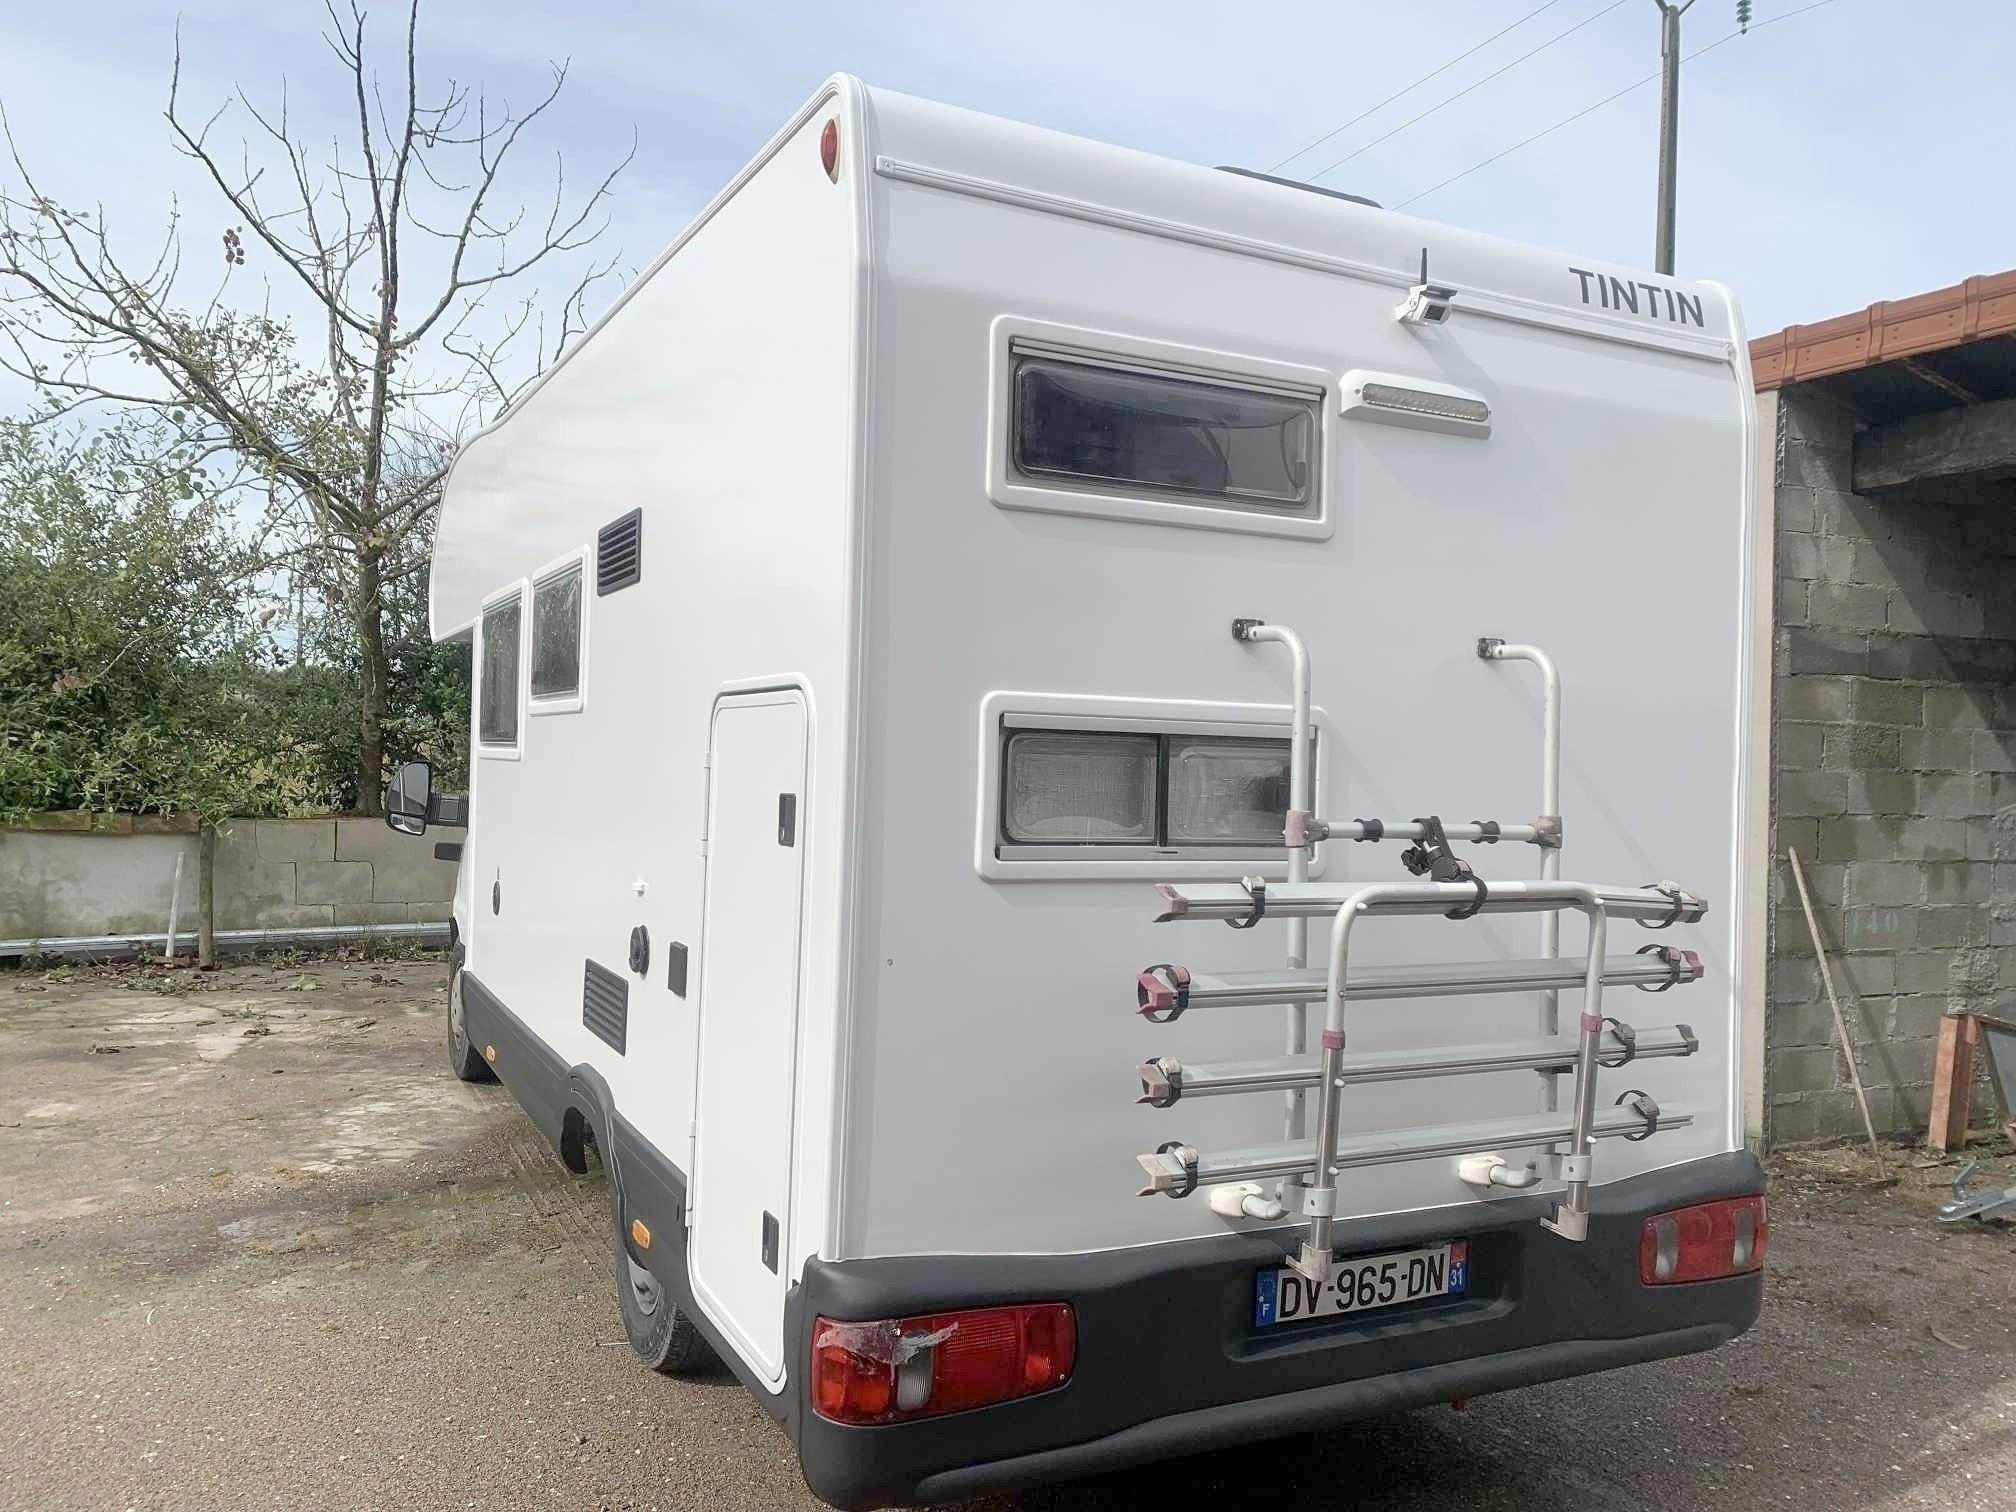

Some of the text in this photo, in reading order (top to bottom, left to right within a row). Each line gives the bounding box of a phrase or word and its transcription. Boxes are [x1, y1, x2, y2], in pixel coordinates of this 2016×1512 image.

[1568, 267, 1704, 328] TINTIN
[1262, 1253, 1463, 1318] F DV-965-DN 31
